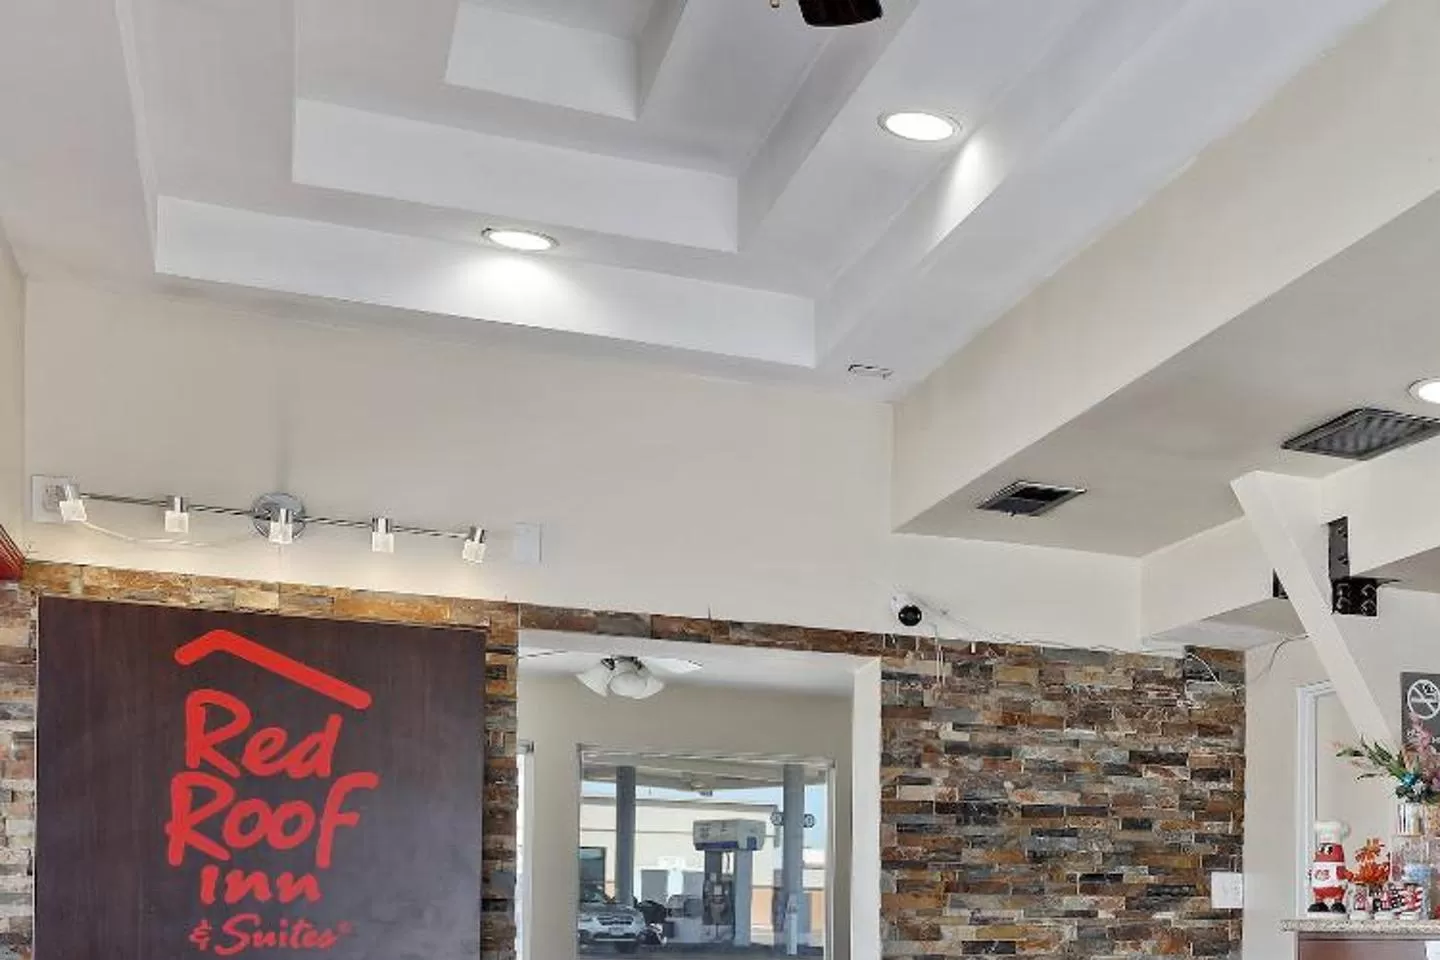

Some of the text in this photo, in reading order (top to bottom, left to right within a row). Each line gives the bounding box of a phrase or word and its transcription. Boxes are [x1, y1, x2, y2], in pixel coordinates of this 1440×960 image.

[184, 688, 343, 780] Red
[164, 771, 380, 869] Roof
[189, 922, 211, 950] &
